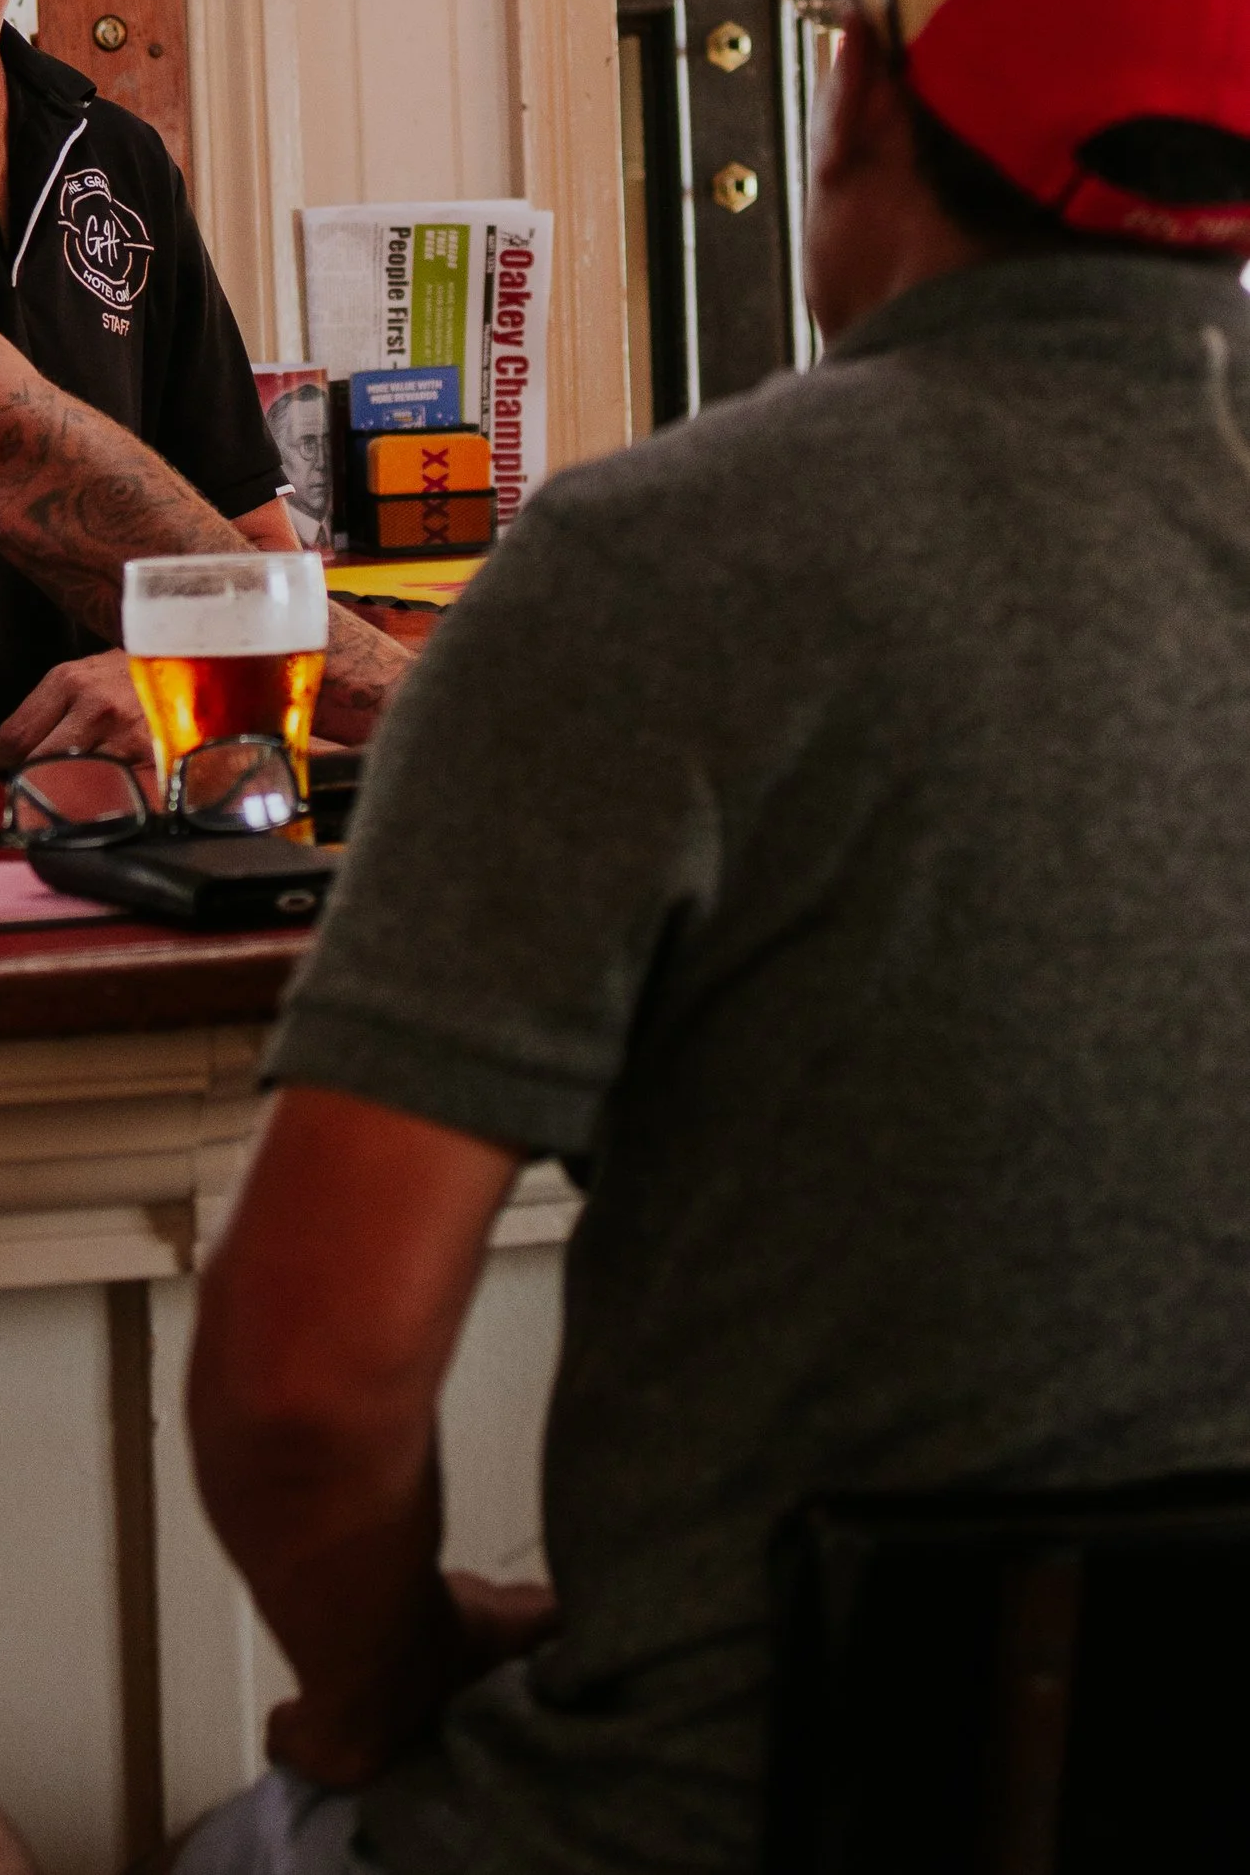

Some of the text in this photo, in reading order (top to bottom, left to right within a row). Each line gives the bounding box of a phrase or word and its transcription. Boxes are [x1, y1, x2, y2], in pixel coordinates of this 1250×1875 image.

[83, 270, 116, 301] HOTEL
[386, 227, 412, 301] People
[493, 249, 535, 348] Oakey
[102, 312, 130, 336] STAFF
[387, 307, 409, 355] First
